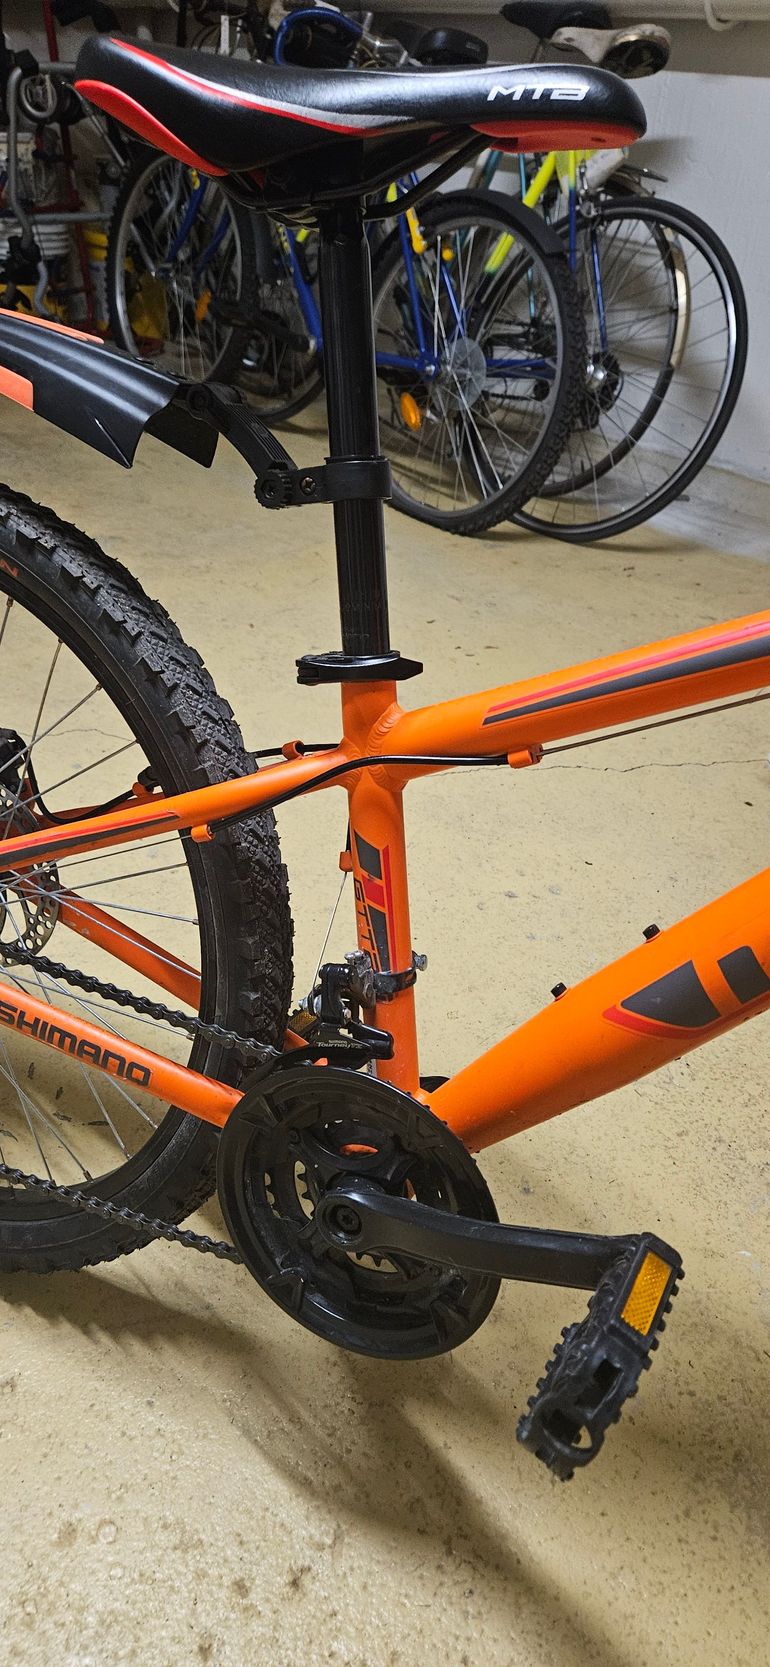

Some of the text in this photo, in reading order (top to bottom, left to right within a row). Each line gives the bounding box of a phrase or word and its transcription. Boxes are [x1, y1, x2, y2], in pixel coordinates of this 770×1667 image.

[486, 84, 591, 102] MTB
[0, 1001, 153, 1087] SHIMANO
[316, 1041, 351, 1049] Tourney
